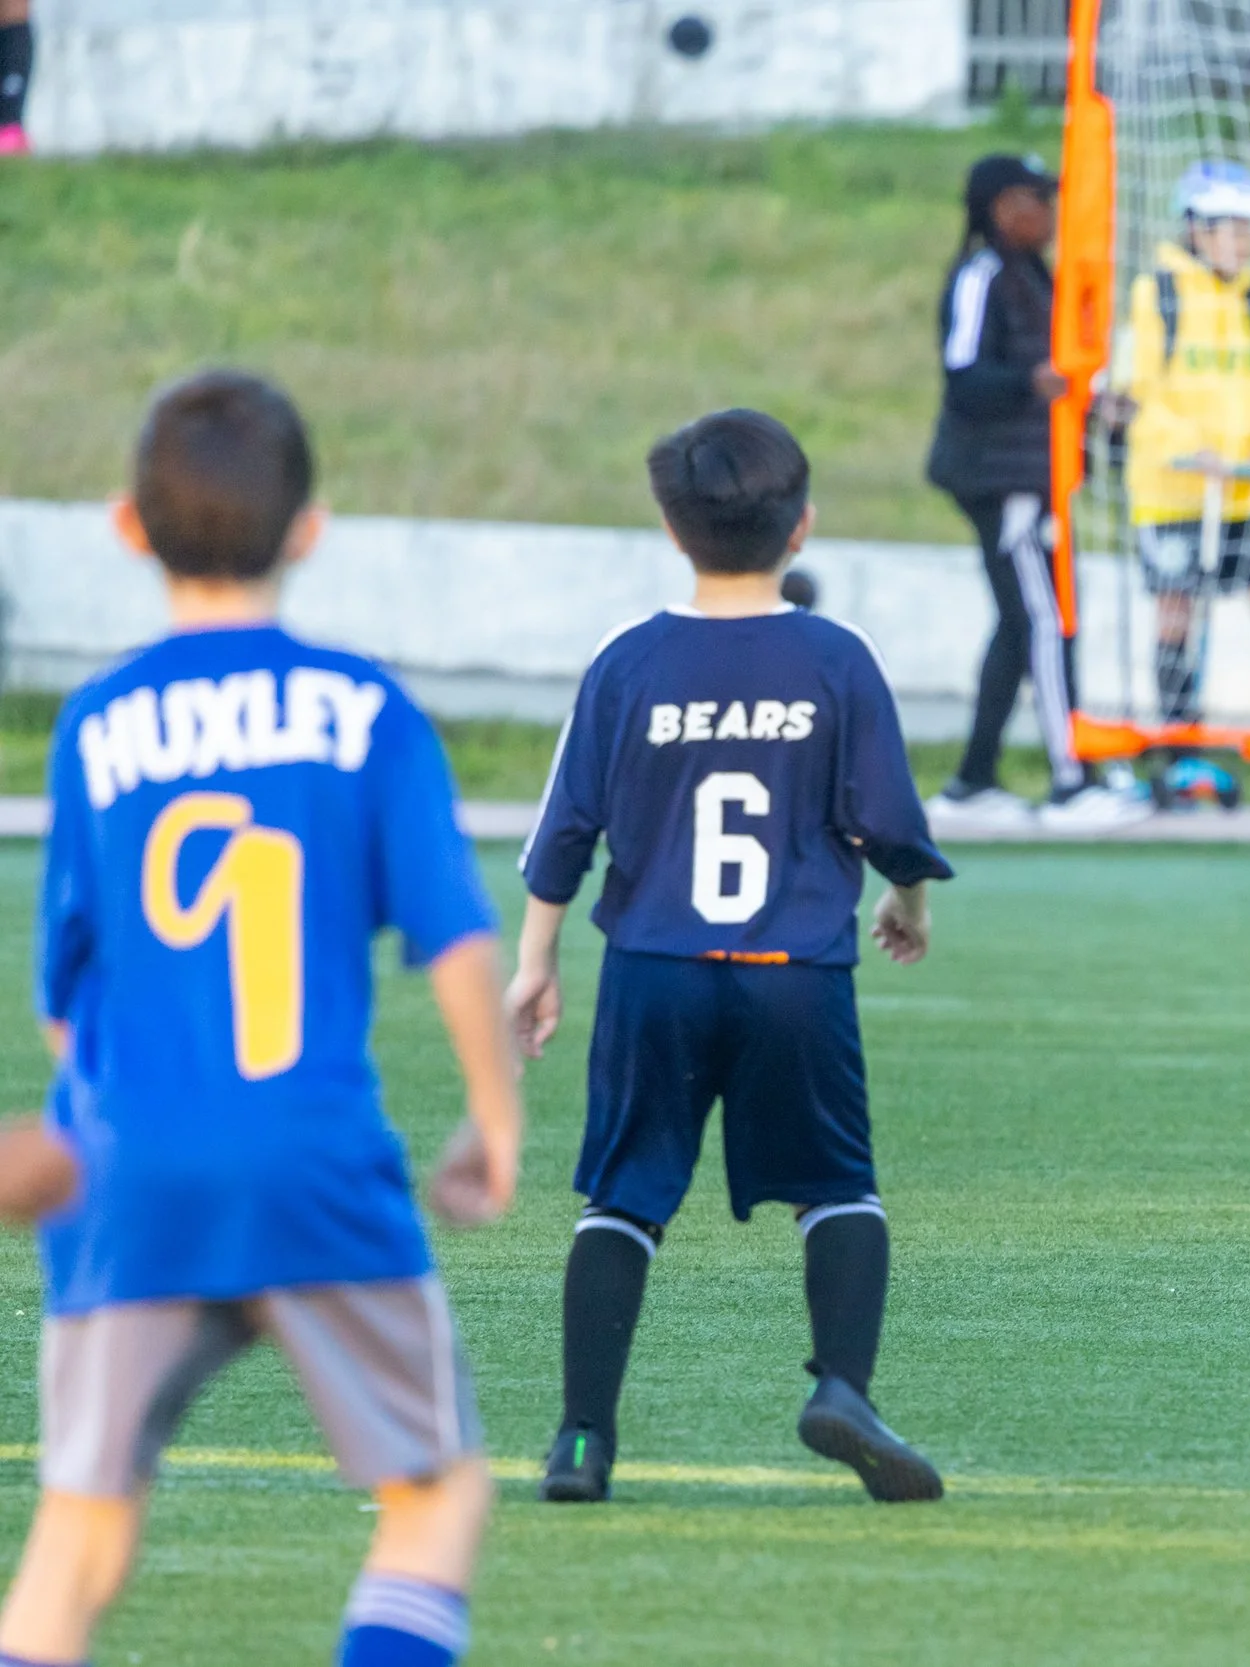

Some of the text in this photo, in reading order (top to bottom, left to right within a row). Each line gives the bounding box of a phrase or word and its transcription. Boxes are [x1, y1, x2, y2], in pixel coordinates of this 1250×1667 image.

[78, 667, 387, 810] HUXLEY
[648, 700, 816, 746] BEARS
[691, 771, 770, 924] 6
[141, 791, 304, 1081] 9
